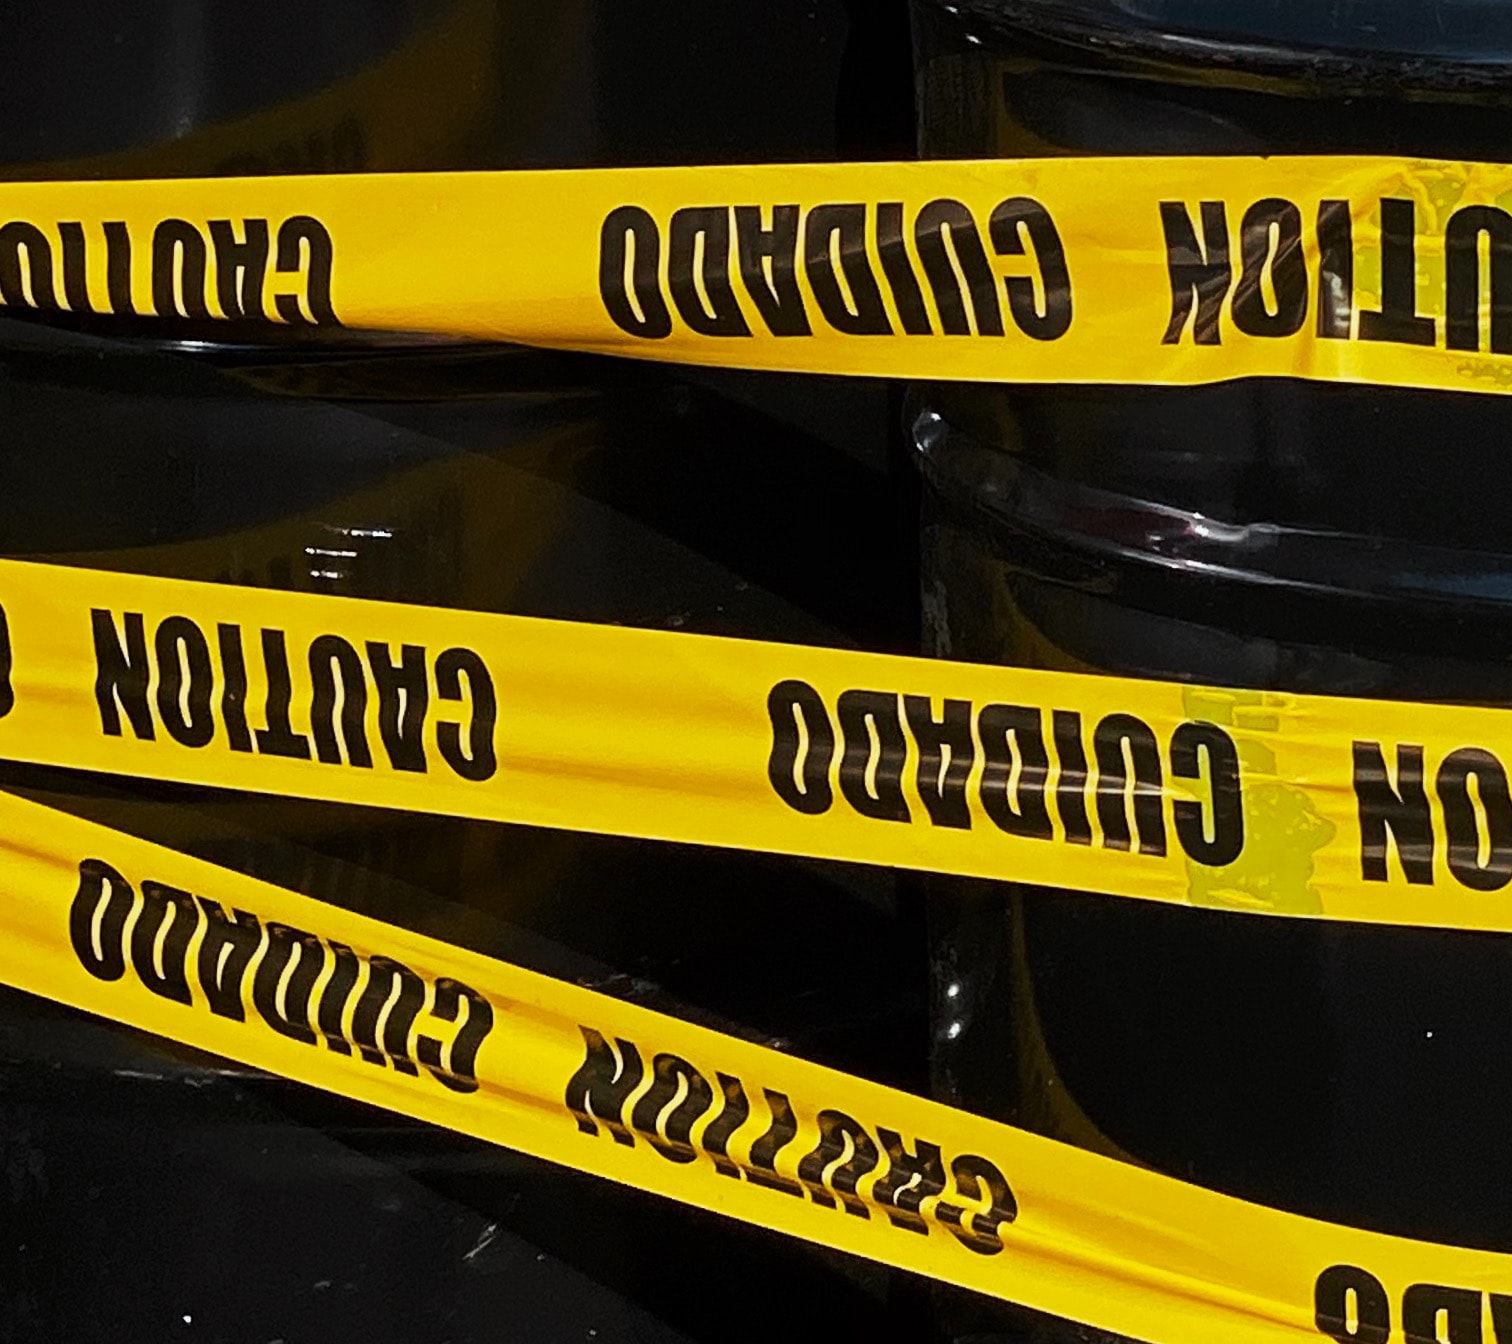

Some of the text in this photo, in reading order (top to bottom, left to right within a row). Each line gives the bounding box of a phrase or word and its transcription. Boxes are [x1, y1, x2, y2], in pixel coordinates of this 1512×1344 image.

[0, 215, 341, 327] CAUTIO
[599, 196, 1073, 341] CUIDADO
[90, 608, 497, 782] CAUTION
[767, 680, 1244, 867] CUIDADO
[70, 858, 494, 1093] CUIDADO
[565, 1024, 1018, 1255] CAUTION
